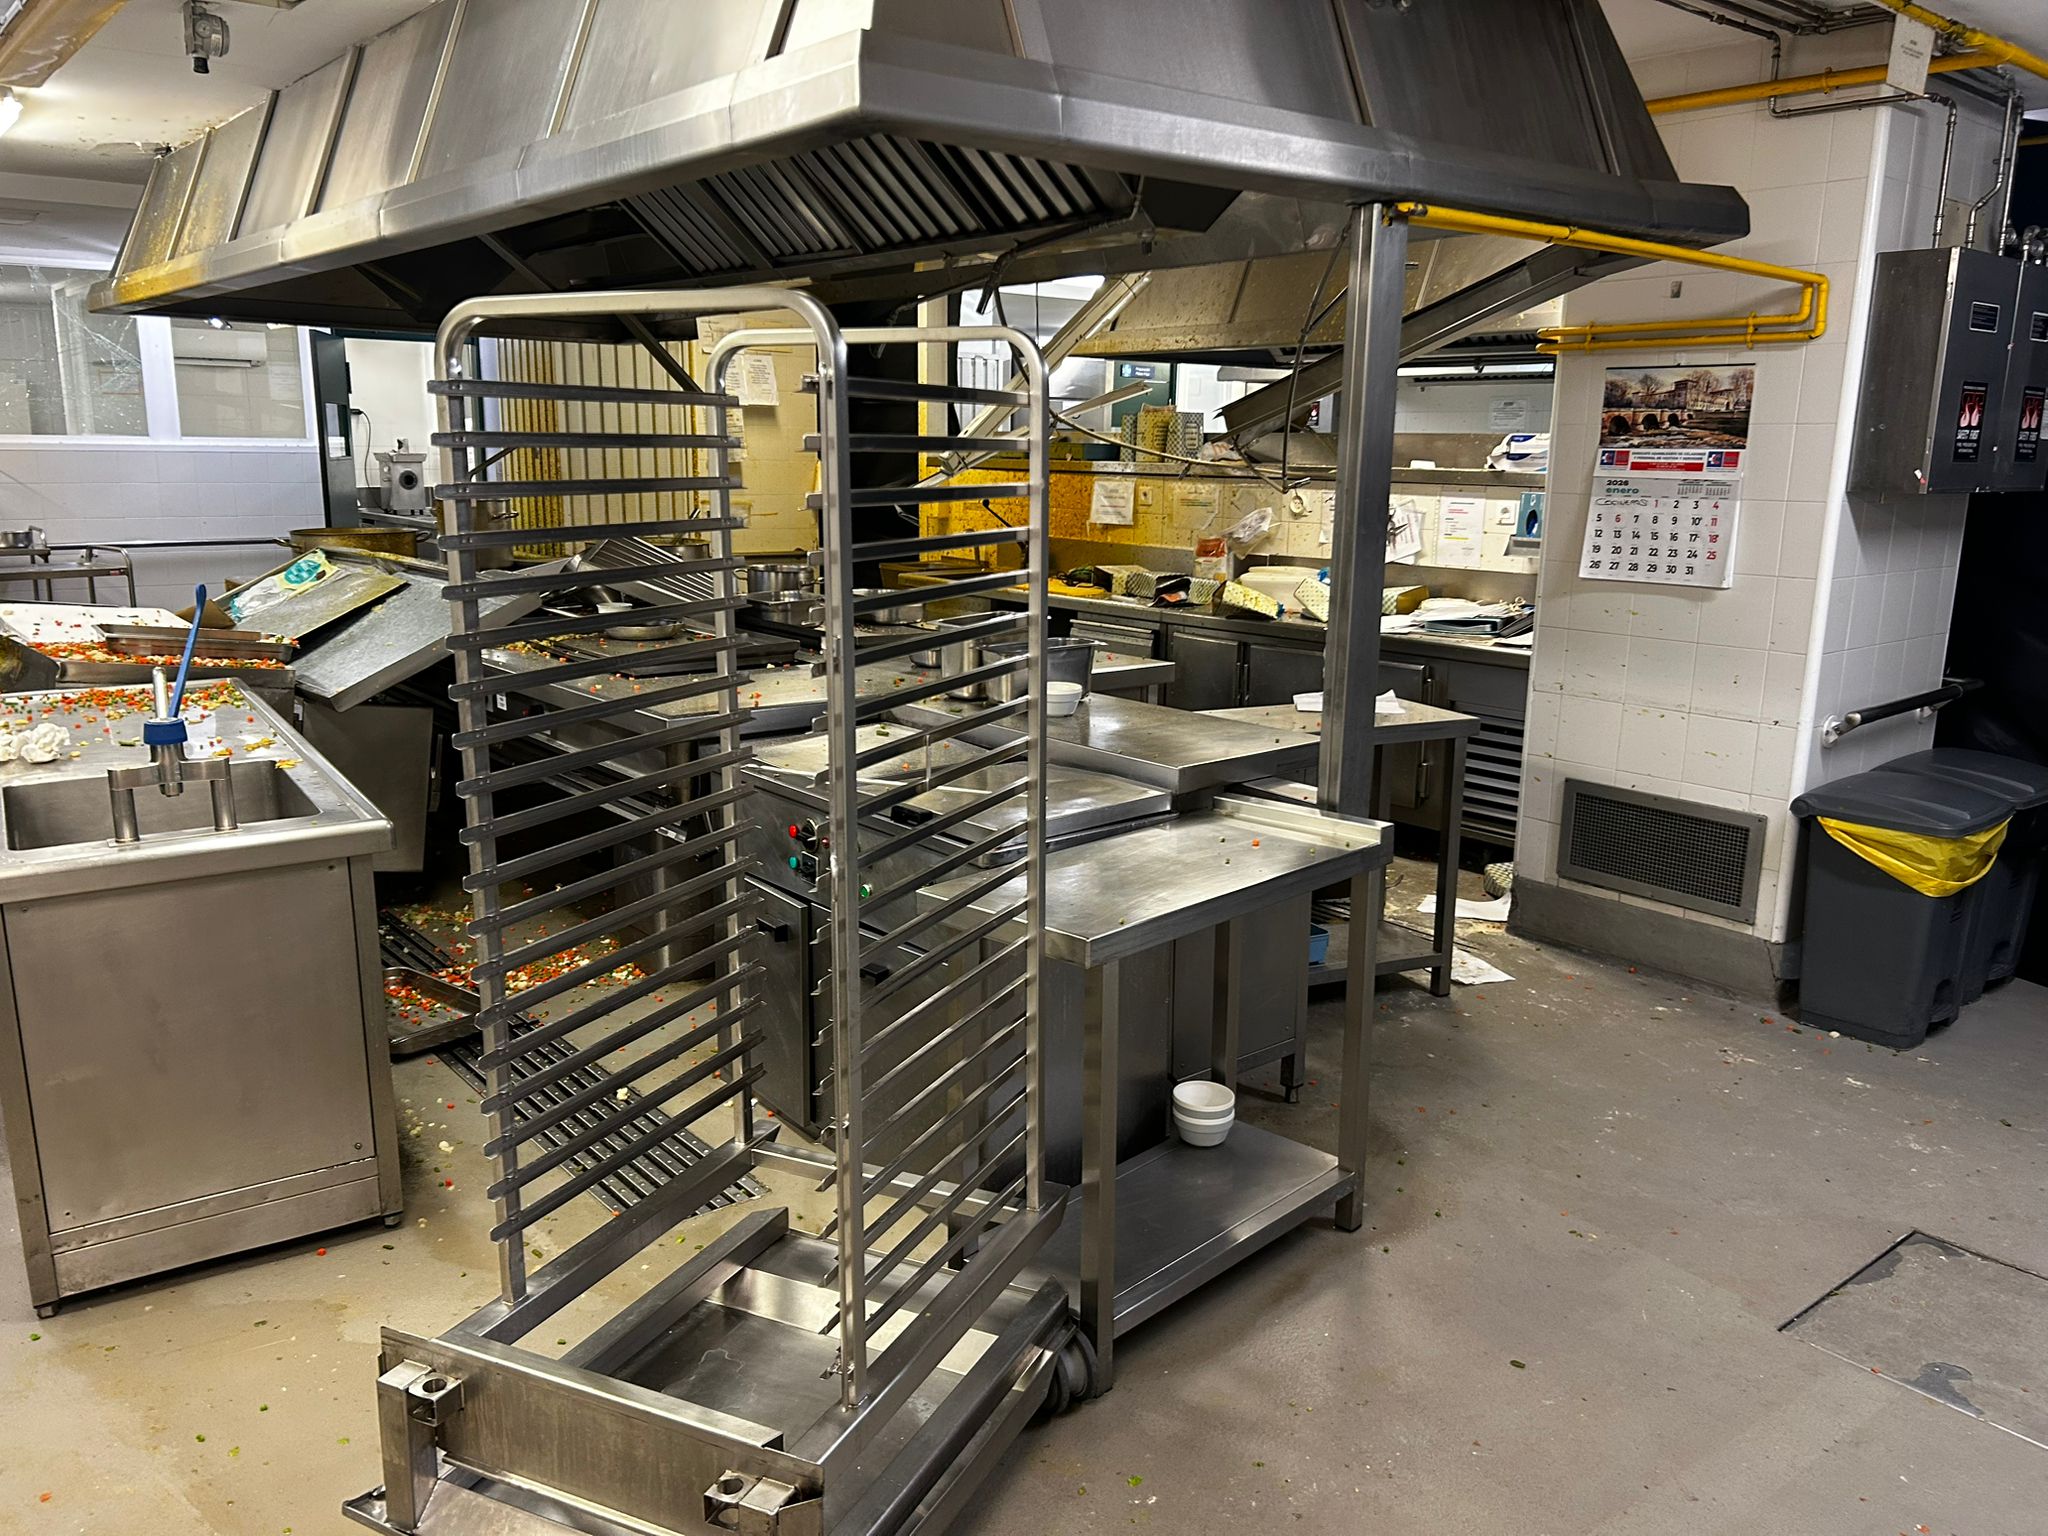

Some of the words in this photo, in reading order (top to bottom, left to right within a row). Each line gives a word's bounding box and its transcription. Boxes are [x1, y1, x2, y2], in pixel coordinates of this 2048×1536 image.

[1673, 500, 1679, 509] 2
[1693, 501, 1699, 509] 3
[1712, 501, 1719, 510] 4
[1596, 514, 1602, 522] 5
[1615, 514, 1621, 523] 6
[1633, 515, 1639, 523] 7
[1652, 515, 1658, 524] 8
[1671, 516, 1678, 525] 9
[1691, 517, 1701, 526] 10
[1711, 517, 1718, 526] 11
[1594, 529, 1603, 538] 12
[1613, 530, 1622, 539] 13
[1631, 530, 1640, 539] 14
[1650, 531, 1659, 541] 15
[1669, 532, 1678, 541] 16
[1592, 544, 1601, 553] 19
[1611, 546, 1622, 554] 20
[1629, 547, 1638, 556] 21
[1648, 548, 1658, 557] 22
[1667, 549, 1678, 558] 23
[1687, 550, 1698, 559] 24
[1706, 551, 1717, 560] 25
[1589, 560, 1601, 569] 26
[1609, 561, 1619, 570] 27
[1628, 562, 1639, 571] 28
[1647, 563, 1657, 573] 29
[1666, 565, 1677, 574] 30
[1685, 566, 1694, 575] 31
